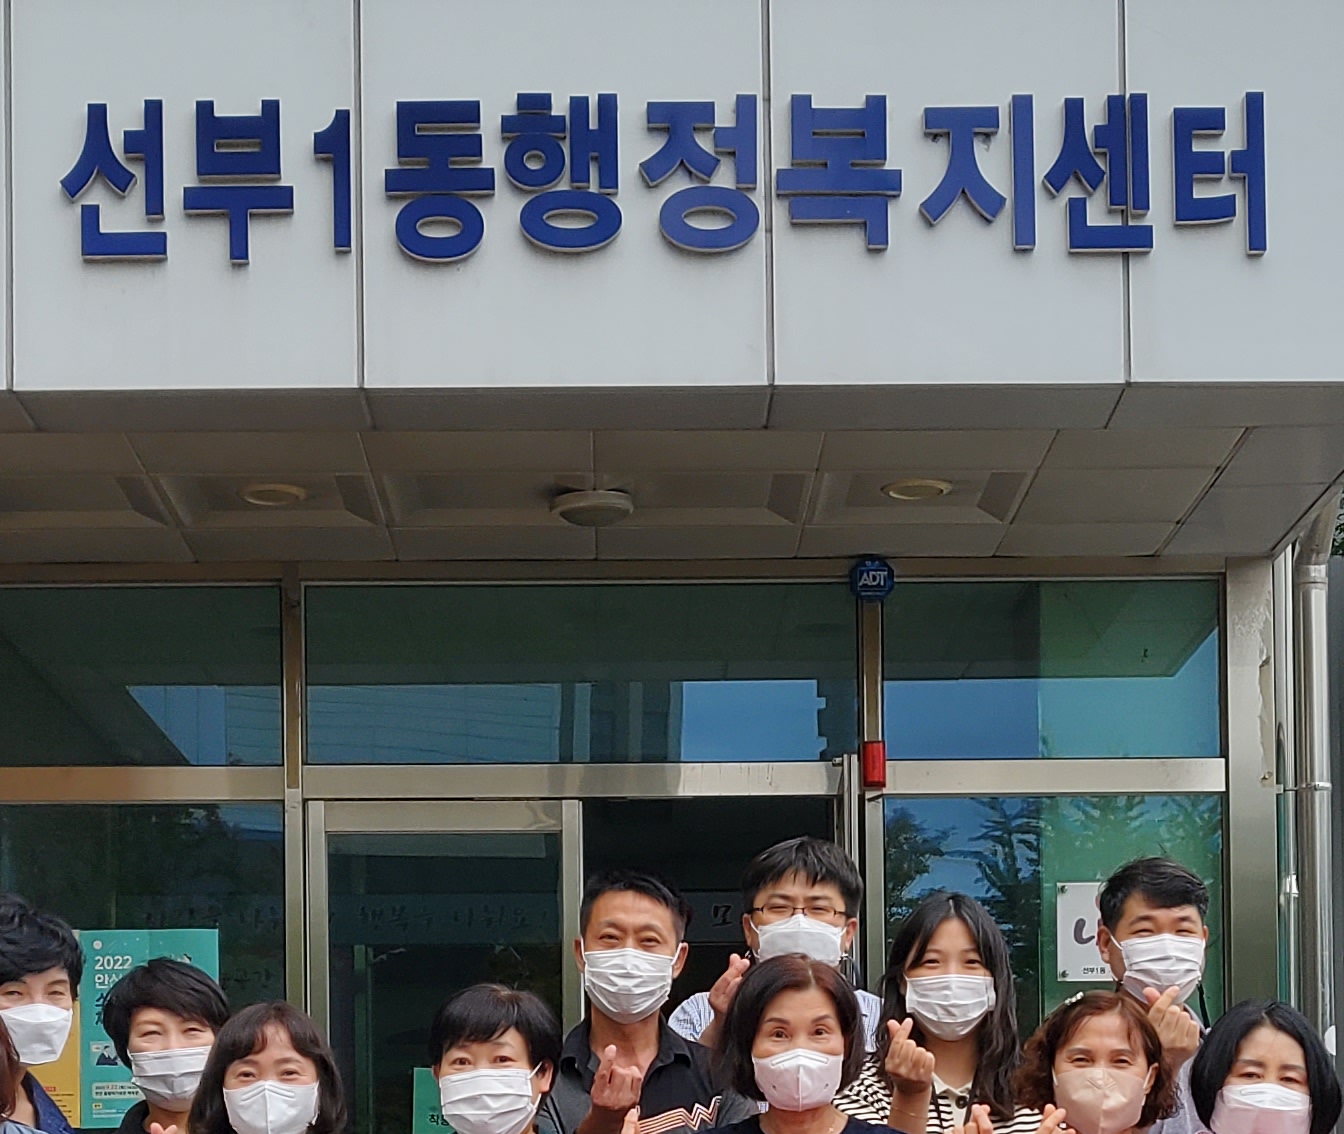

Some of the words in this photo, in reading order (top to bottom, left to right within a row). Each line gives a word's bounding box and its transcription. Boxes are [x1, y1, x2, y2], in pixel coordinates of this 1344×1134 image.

[60, 90, 1269, 264] 선부1동행정복지센터
[858, 571, 888, 586] ADT
[94, 955, 133, 970] 2022
